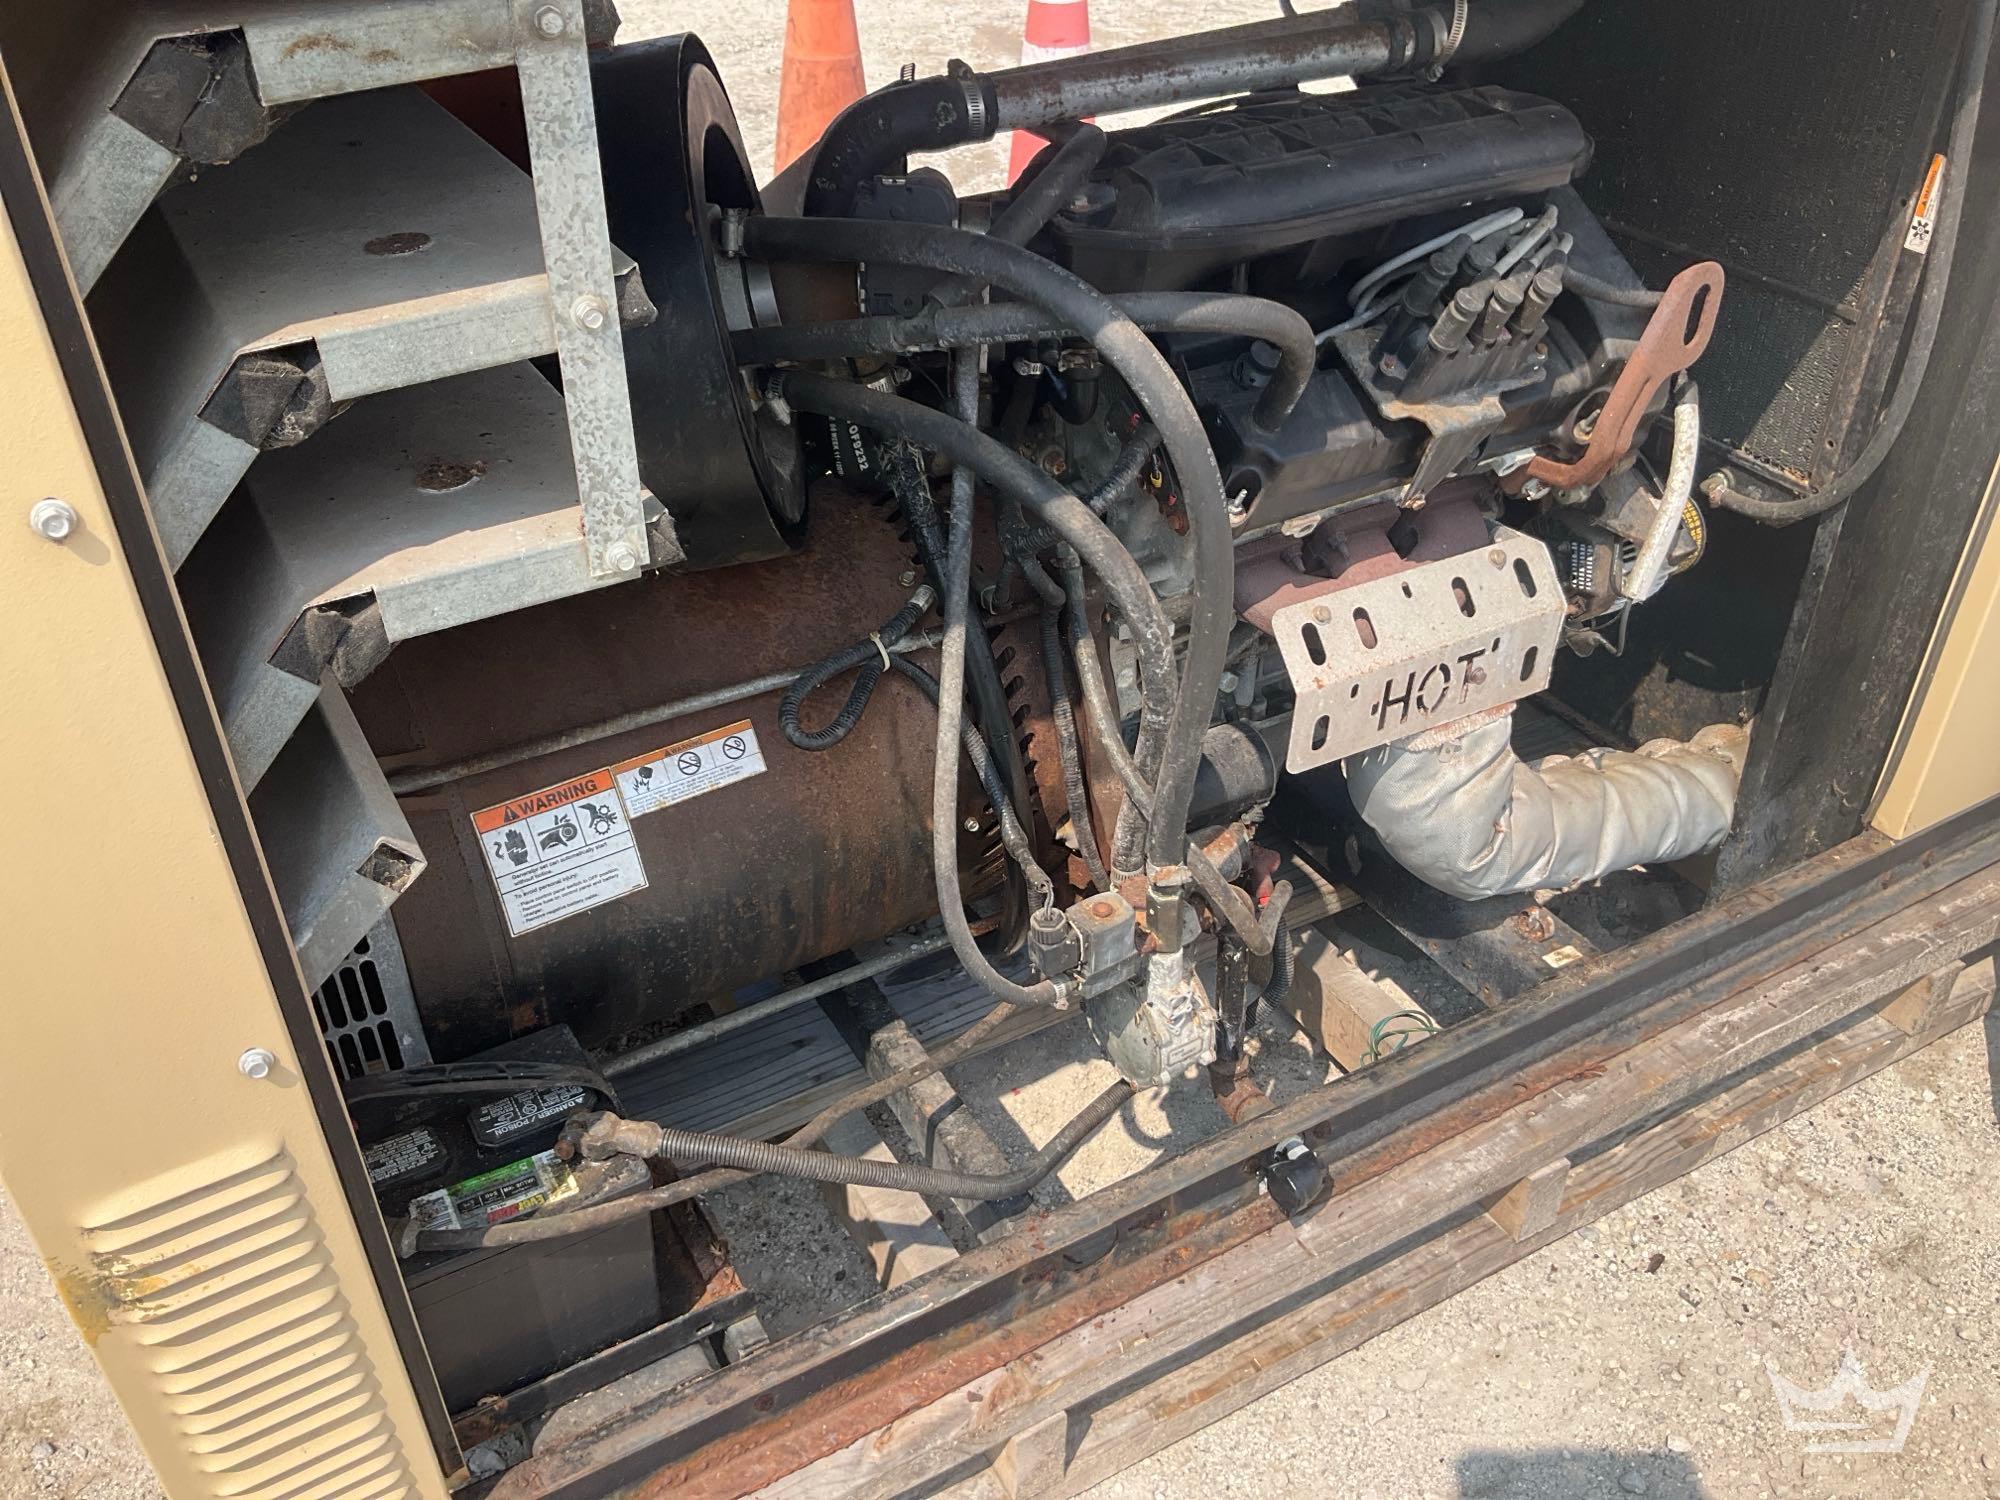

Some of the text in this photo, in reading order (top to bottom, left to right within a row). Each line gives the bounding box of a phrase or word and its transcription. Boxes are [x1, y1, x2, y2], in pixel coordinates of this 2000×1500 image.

[1377, 648, 1487, 732] HOT
[517, 778, 597, 815] WARNING
[511, 866, 539, 880] Generator
[559, 846, 594, 863] automatically
[595, 841, 607, 849] start
[513, 875, 534, 886] without
[522, 887, 538, 896] avoid
[538, 878, 562, 891] personal
[536, 1099, 576, 1119] DANGER
[494, 1118, 529, 1135] POISON
